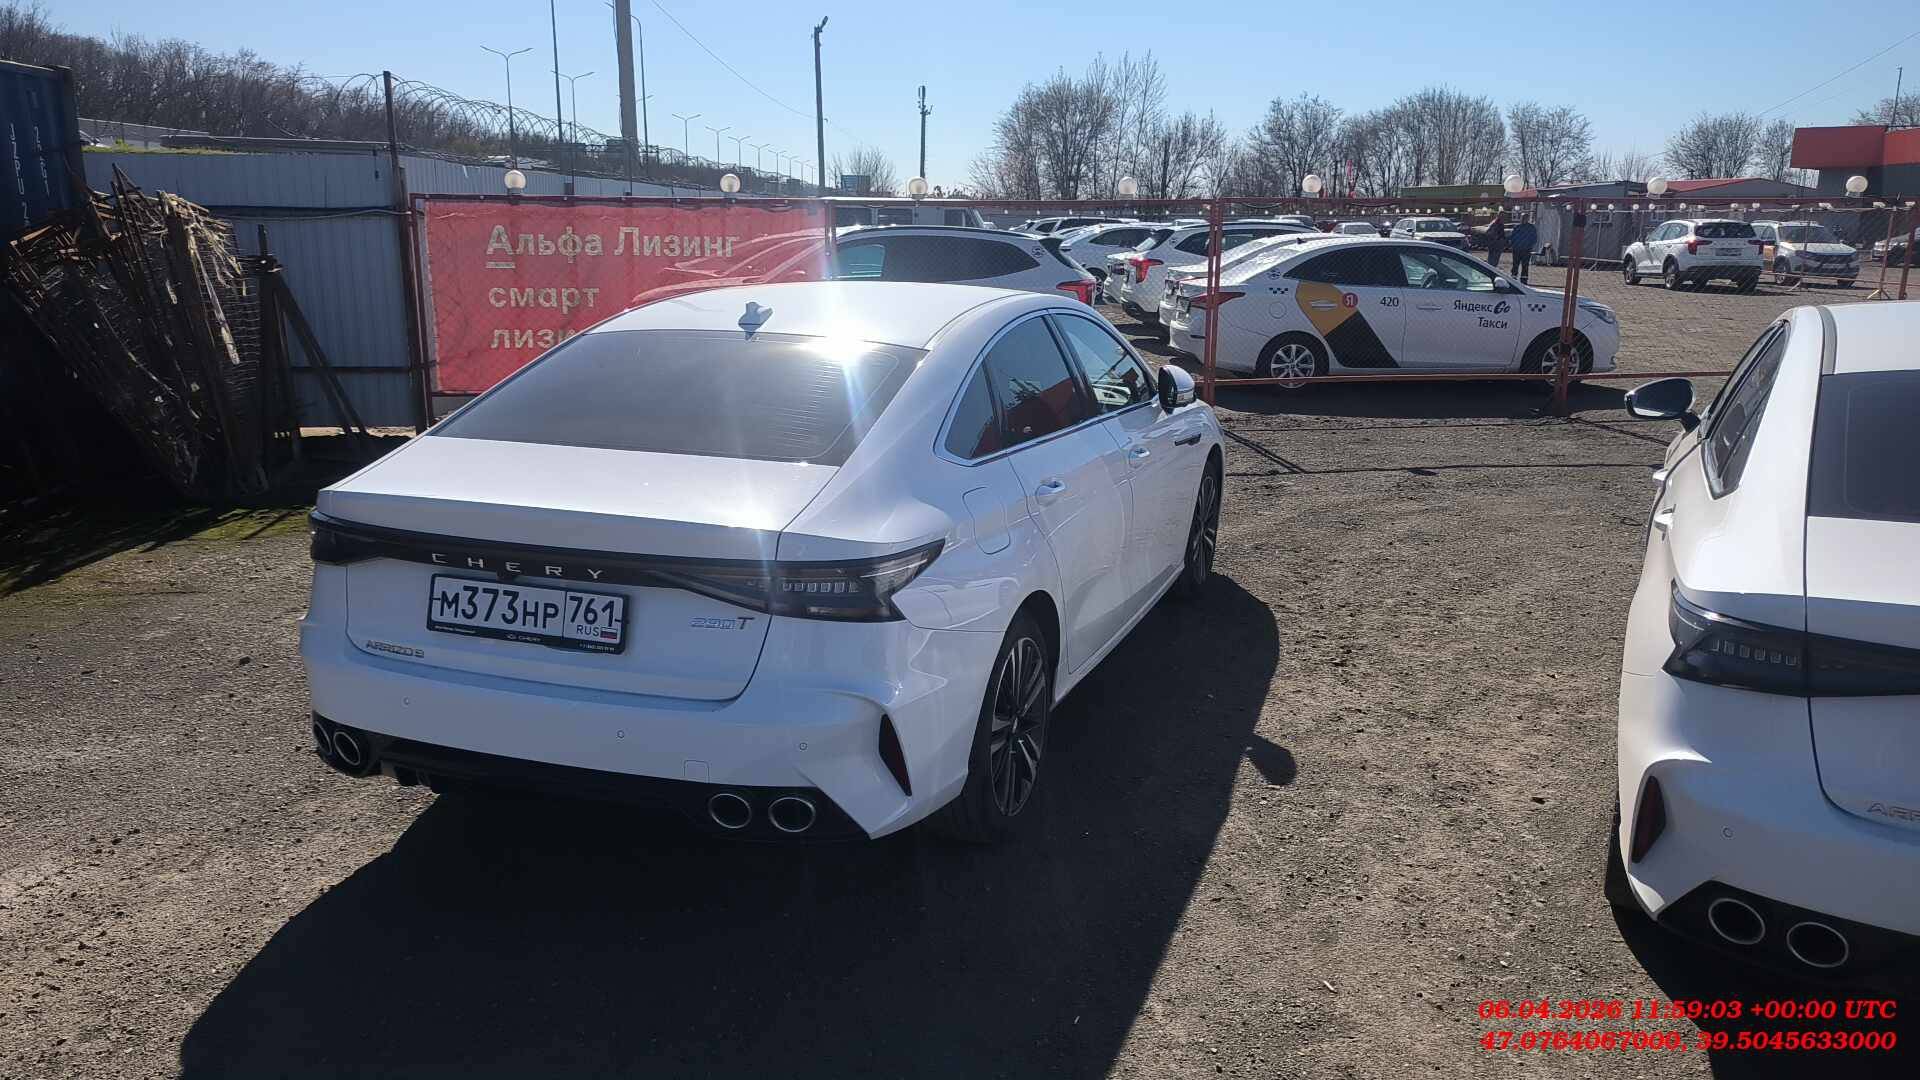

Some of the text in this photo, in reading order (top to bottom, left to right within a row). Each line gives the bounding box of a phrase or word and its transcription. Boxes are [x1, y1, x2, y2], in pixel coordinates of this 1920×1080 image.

[486, 224, 737, 263] Альфа Лизинг
[488, 286, 600, 314] смарт
[1379, 296, 1400, 308] 420
[1453, 300, 1493, 314] Яндекс
[1477, 316, 1509, 330] Такси
[432, 552, 604, 580] CHERY
[568, 595, 618, 627] 761
[576, 624, 600, 637] RUS
